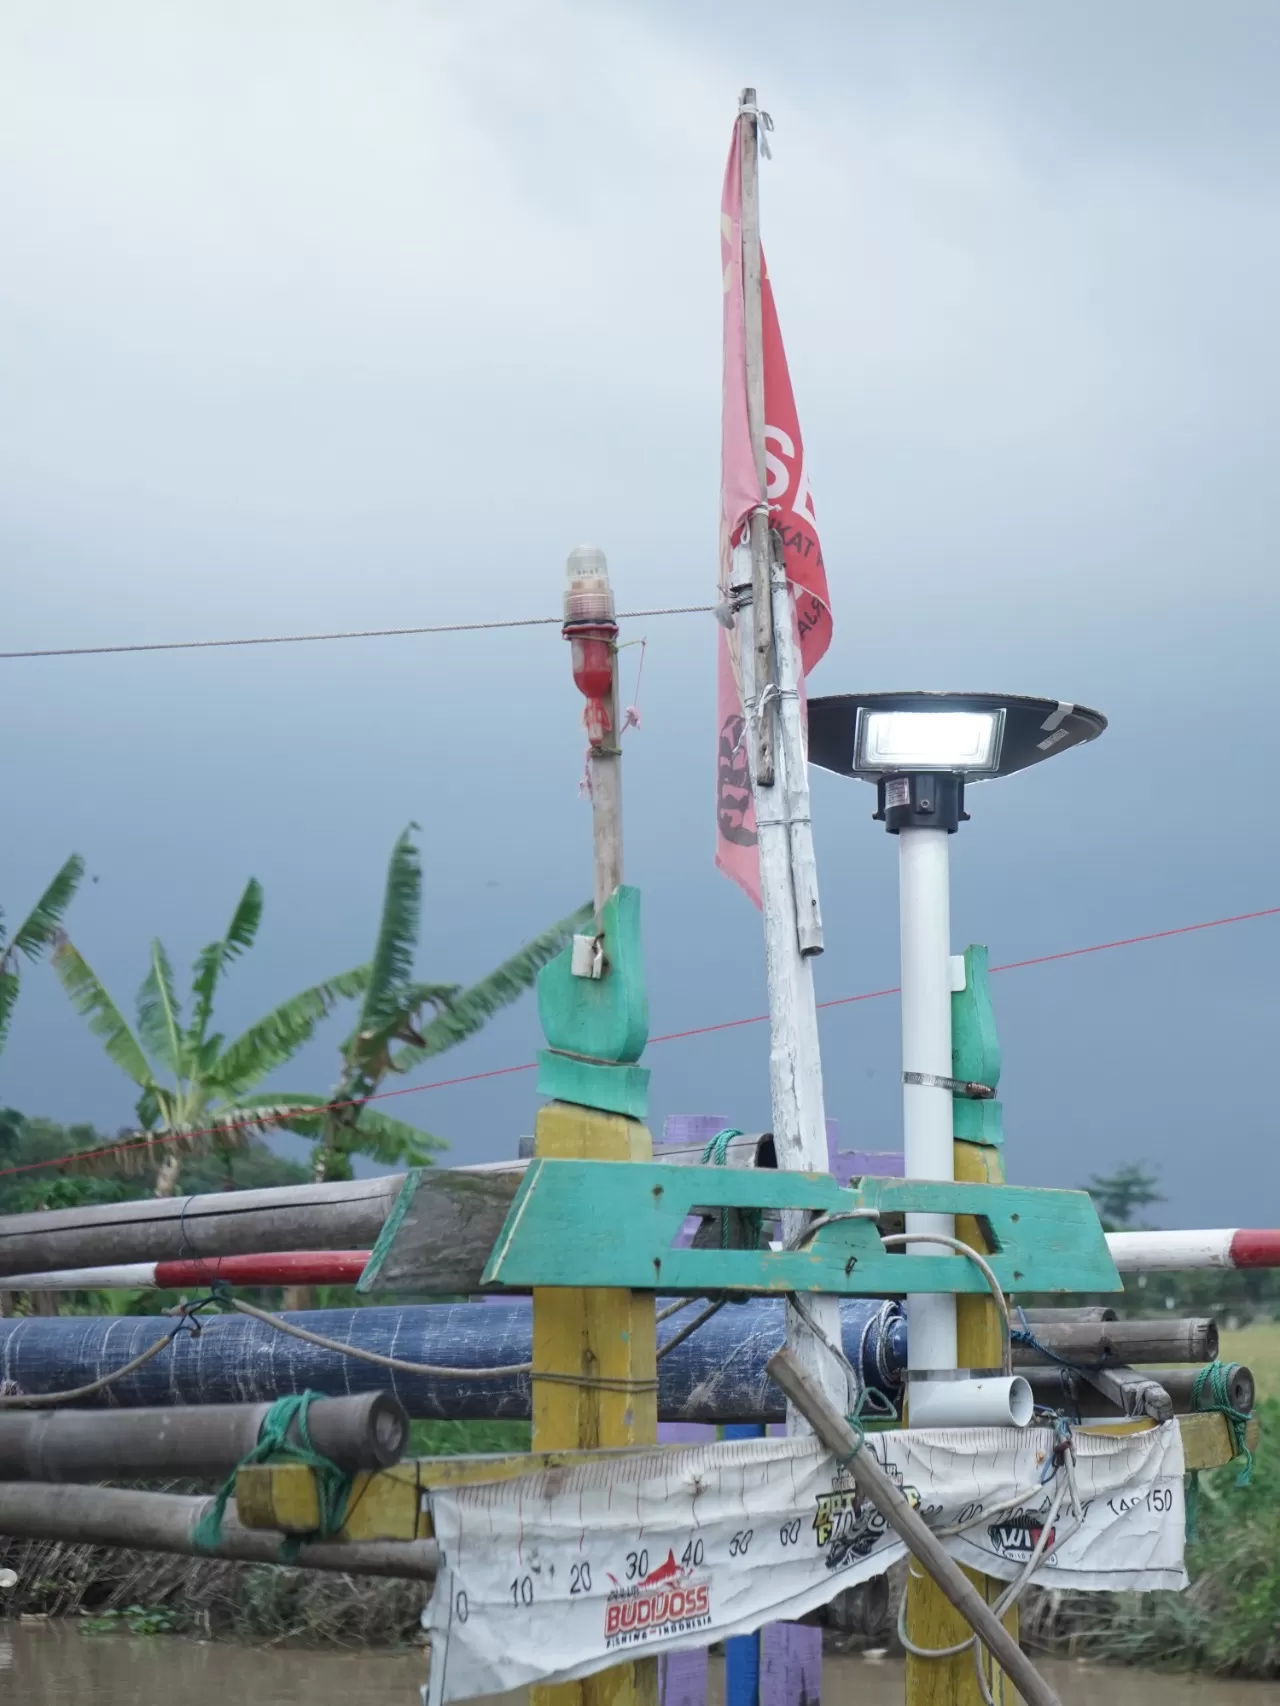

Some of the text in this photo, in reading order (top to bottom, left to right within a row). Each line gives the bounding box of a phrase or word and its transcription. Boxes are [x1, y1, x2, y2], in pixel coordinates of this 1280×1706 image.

[456, 1591, 468, 1624] 0
[510, 1576, 533, 1608] 10
[570, 1562, 592, 1594] 20
[625, 1548, 649, 1580] 30
[681, 1538, 704, 1567] 40
[729, 1529, 754, 1557] 50
[779, 1518, 802, 1547] 60
[1145, 1488, 1173, 1512] 150
[658, 1615, 713, 1637] INDONESIA
